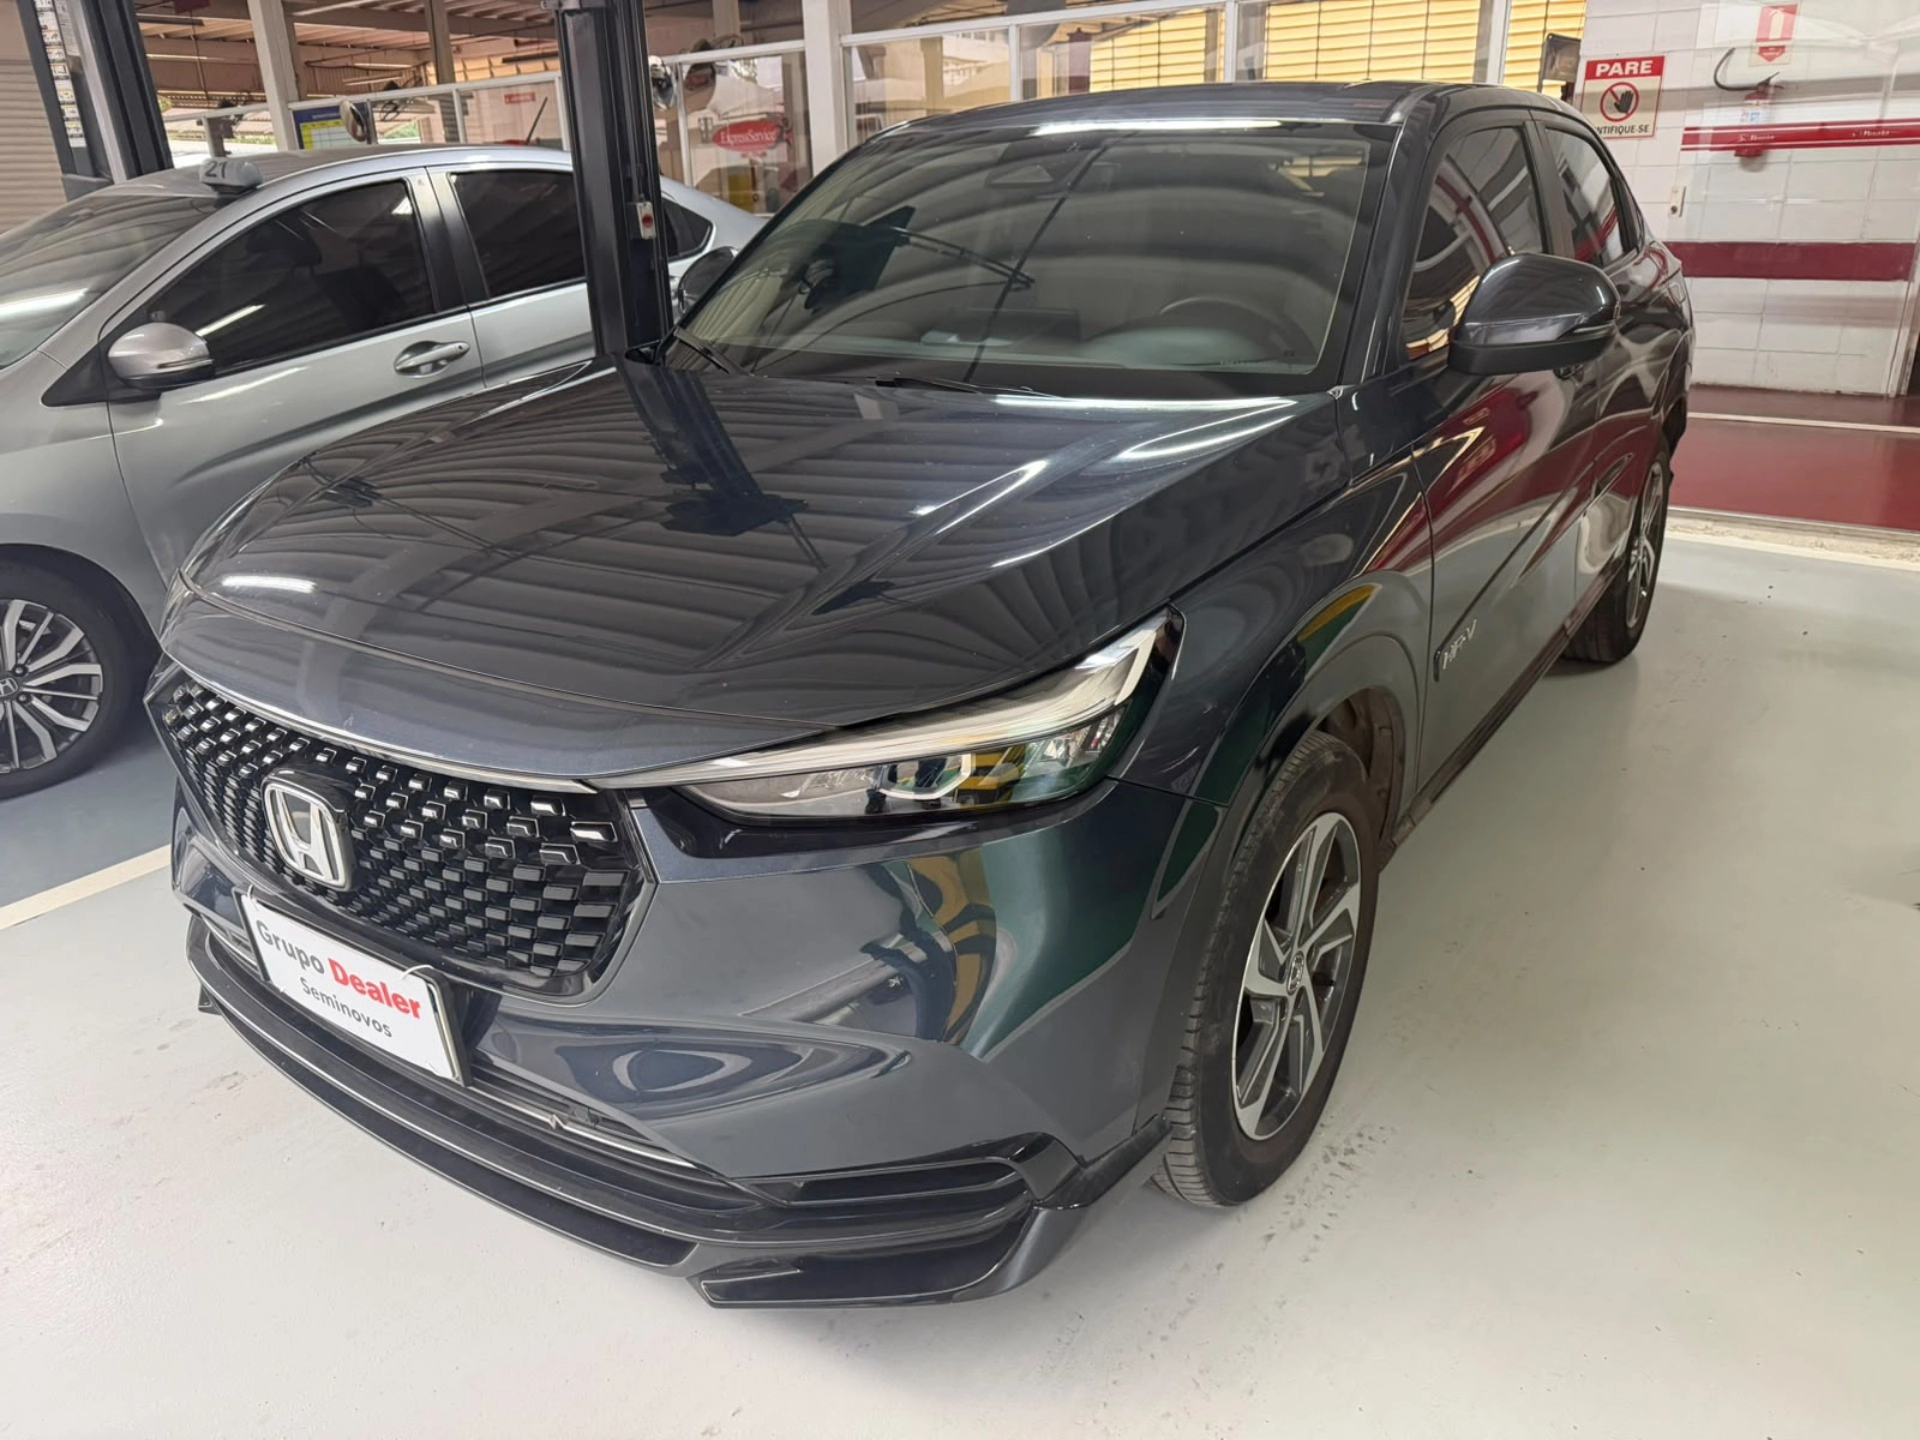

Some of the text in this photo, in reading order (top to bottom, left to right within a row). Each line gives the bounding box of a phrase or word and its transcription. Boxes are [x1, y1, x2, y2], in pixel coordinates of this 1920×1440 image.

[1596, 60, 1654, 77] PARE
[1595, 124, 1650, 135] NTIFIQUE-SE
[204, 160, 228, 179] 21
[255, 919, 422, 1019] Grupo Dealer
[299, 977, 393, 1038] Seminovos
